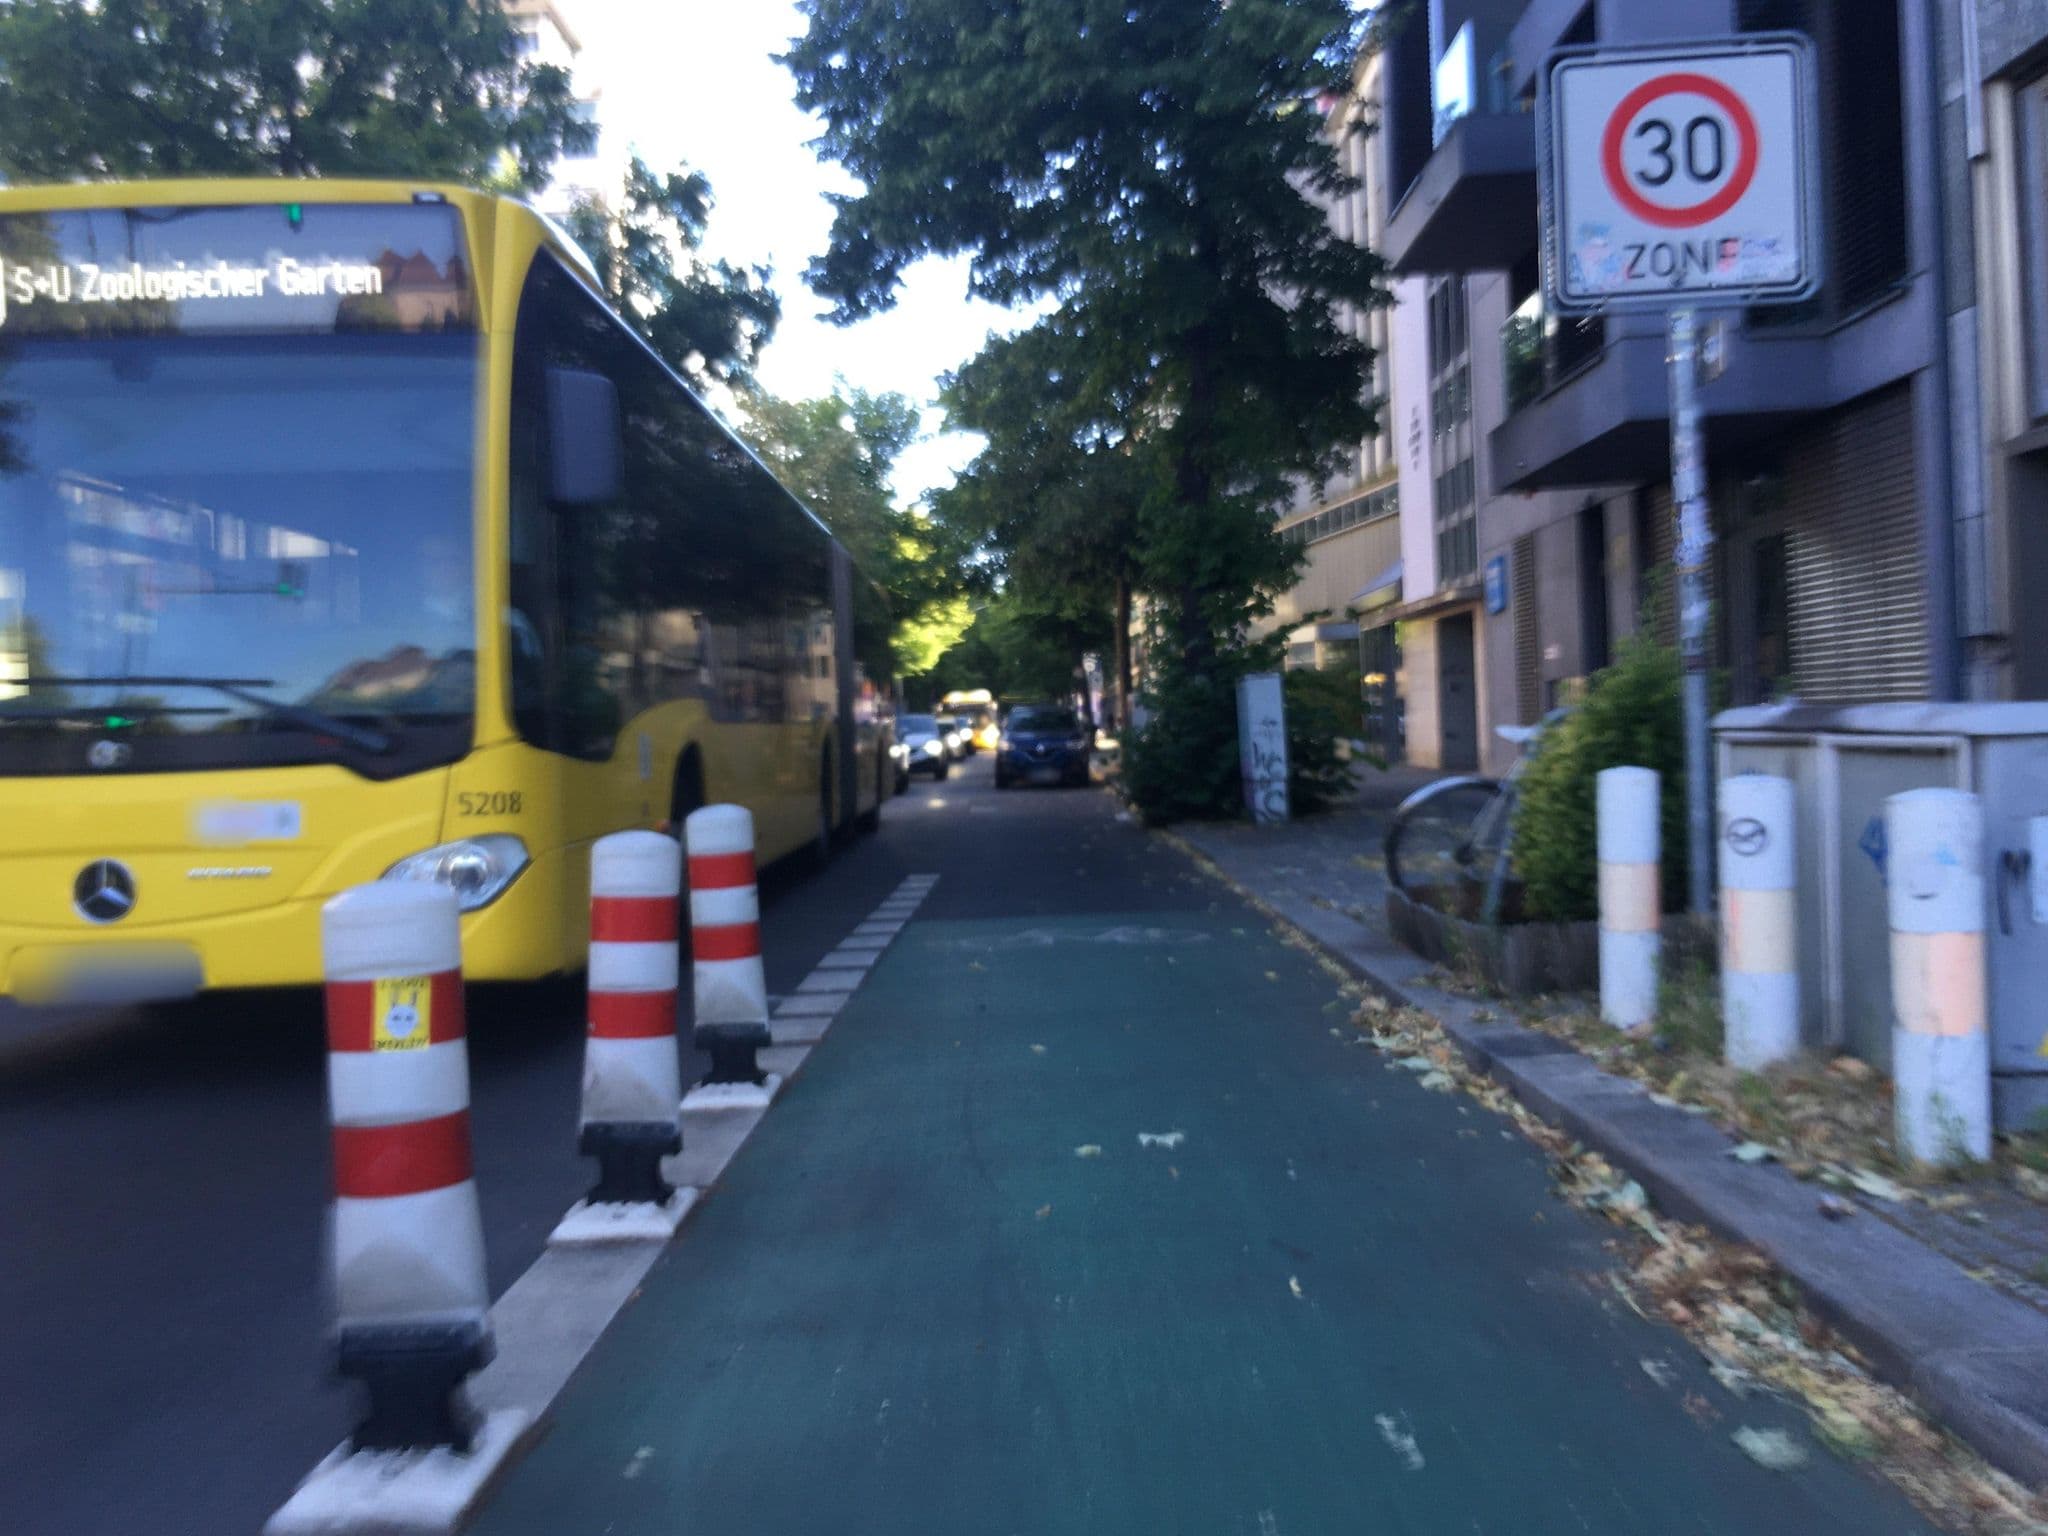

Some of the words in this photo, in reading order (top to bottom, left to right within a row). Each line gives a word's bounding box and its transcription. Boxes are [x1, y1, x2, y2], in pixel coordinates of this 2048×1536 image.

[1635, 116, 1723, 186] 30
[14, 264, 71, 303] S+U
[80, 261, 268, 301] Zoologischer
[278, 257, 382, 295] Garten
[459, 791, 522, 816] 5208
